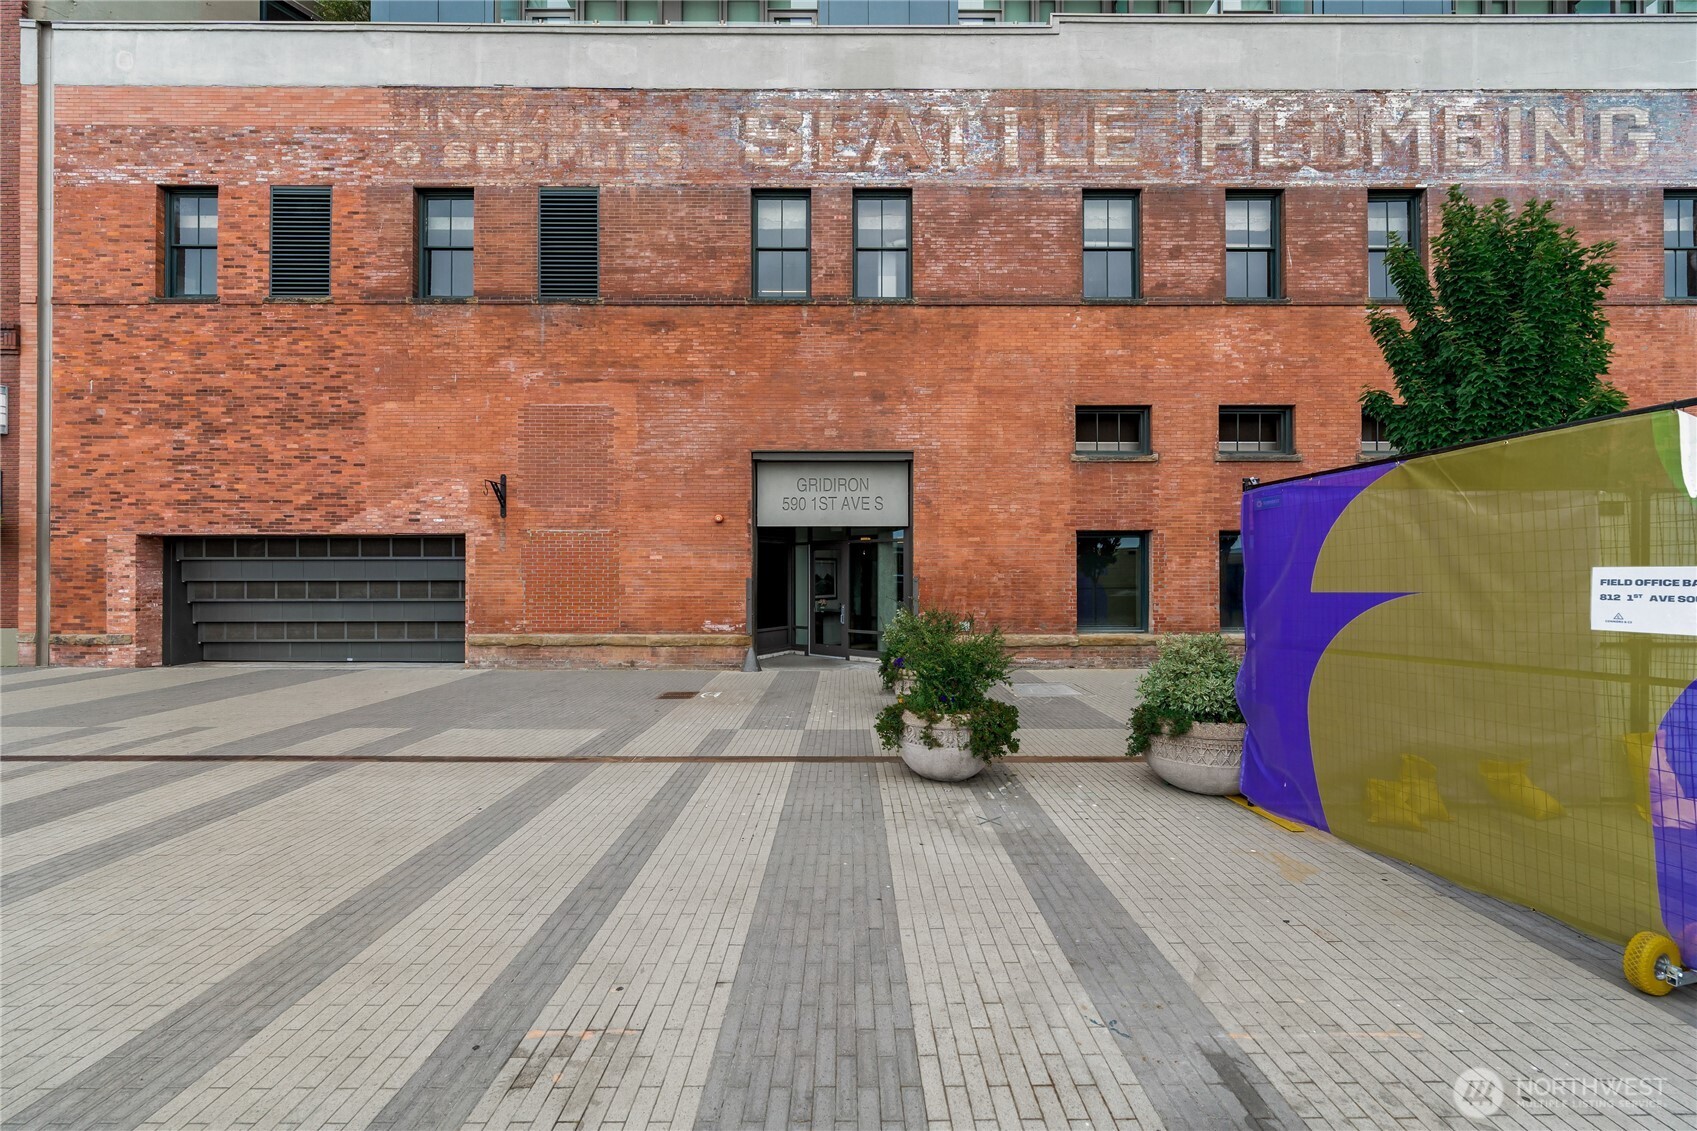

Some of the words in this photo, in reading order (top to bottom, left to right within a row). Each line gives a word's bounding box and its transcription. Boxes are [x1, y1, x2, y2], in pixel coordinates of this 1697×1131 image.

[743, 105, 1139, 167] SEATTLE
[1200, 106, 1655, 167] PLUMBING
[796, 477, 869, 492] GRIDIRON
[782, 496, 806, 511] 590
[811, 496, 837, 511] 1ST
[841, 496, 870, 511] AVE
[874, 496, 884, 511] S
[1635, 579, 1680, 587] OFFICE
[1649, 595, 1675, 603] AVE
[1677, 595, 1697, 603] SO
